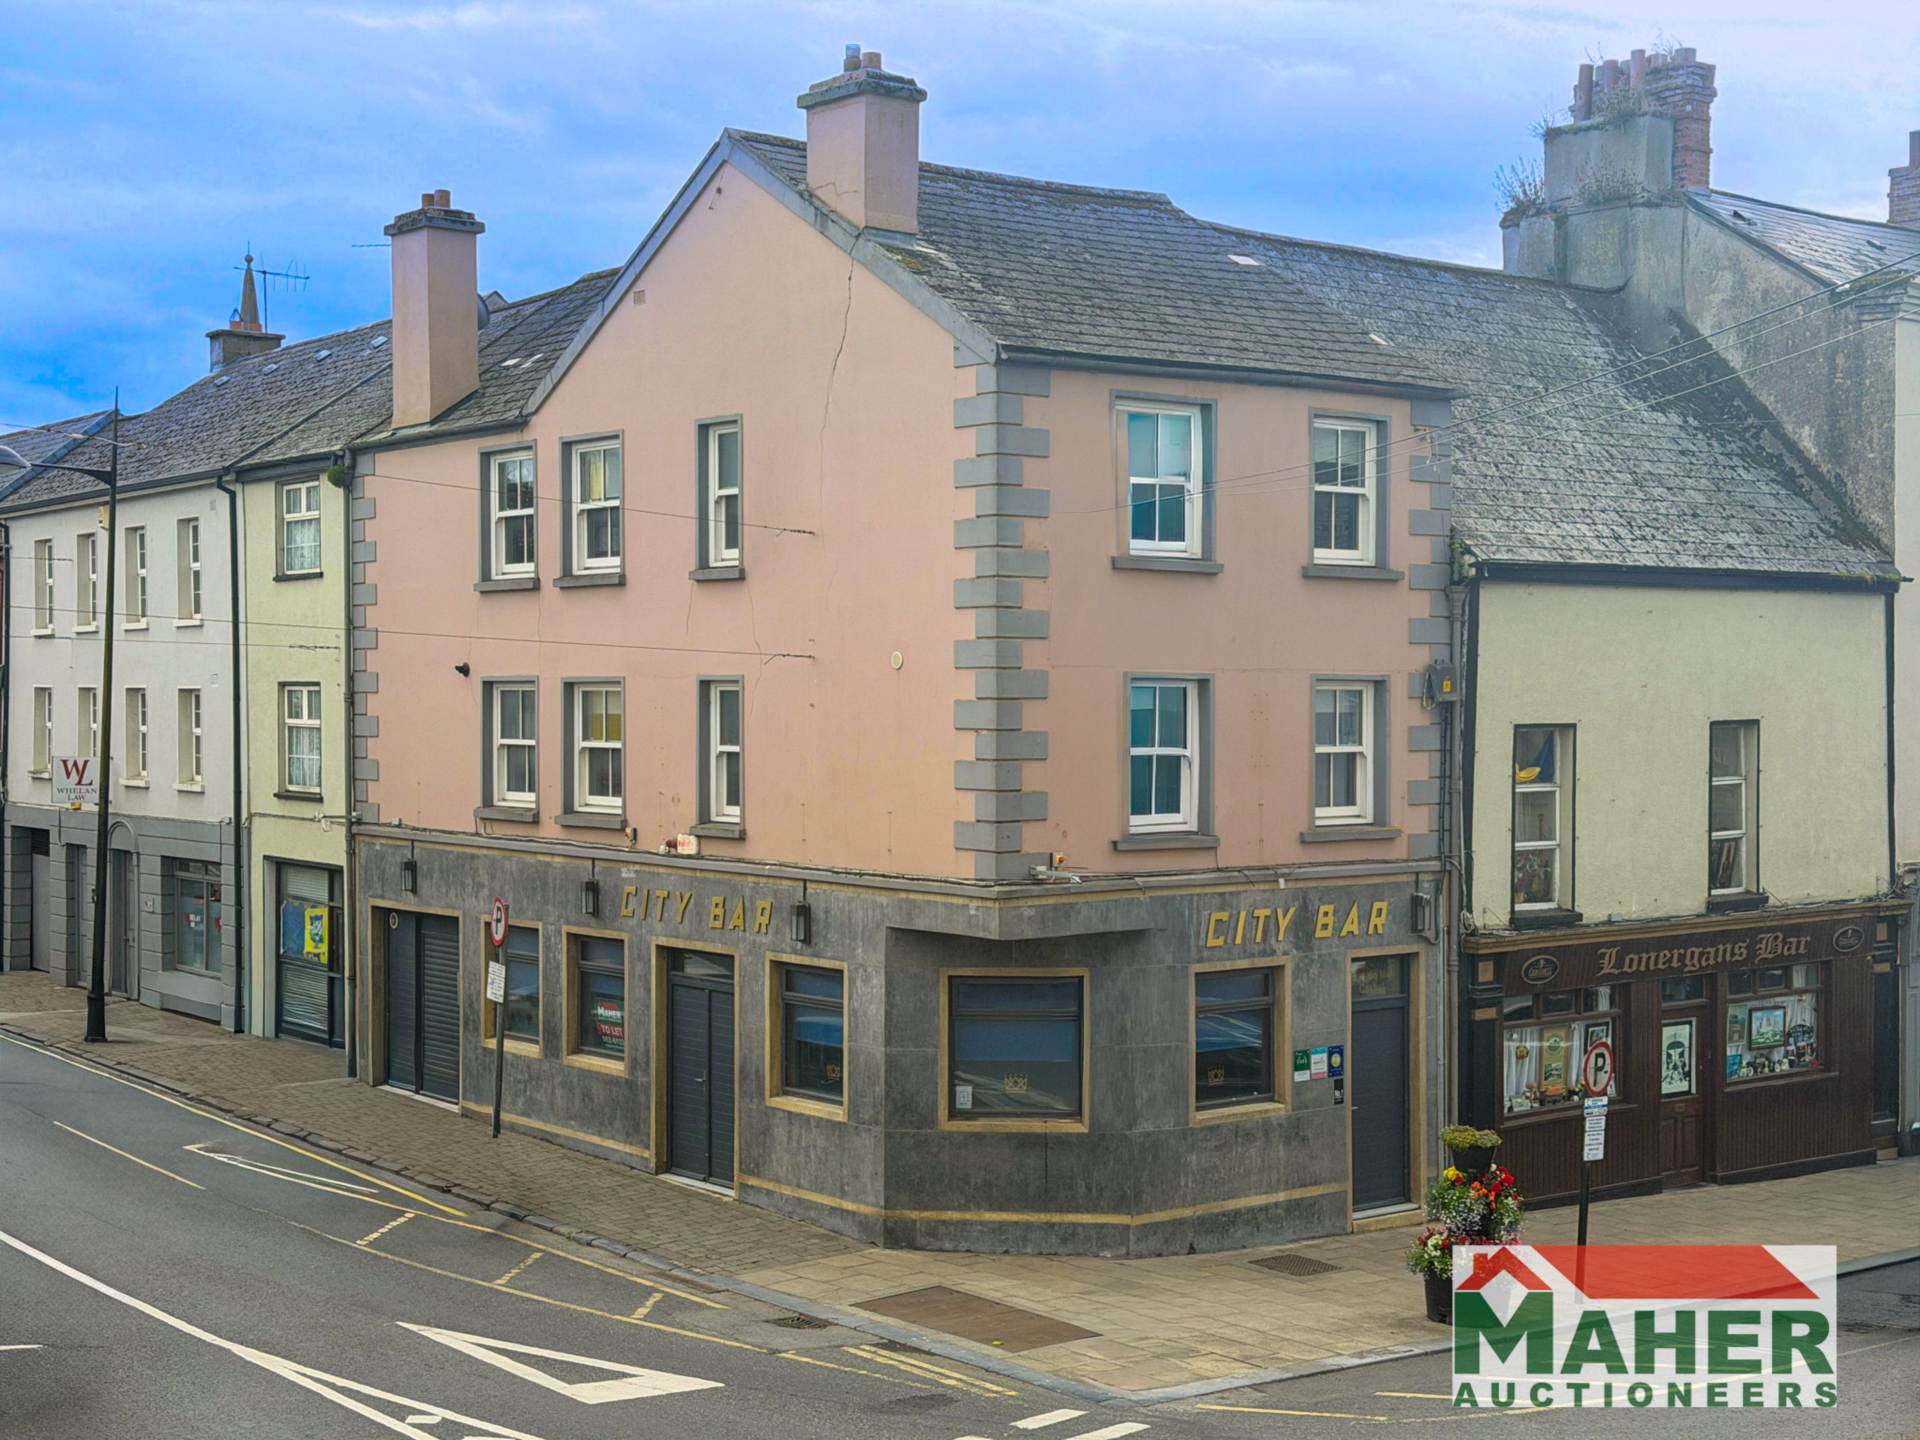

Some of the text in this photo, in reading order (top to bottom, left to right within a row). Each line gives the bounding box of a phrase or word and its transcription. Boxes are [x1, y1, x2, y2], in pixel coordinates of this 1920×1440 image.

[620, 885, 774, 935] CITY BAR
[1205, 900, 1389, 948] CITY BAR
[1597, 932, 1811, 975] Lonergans Bar
